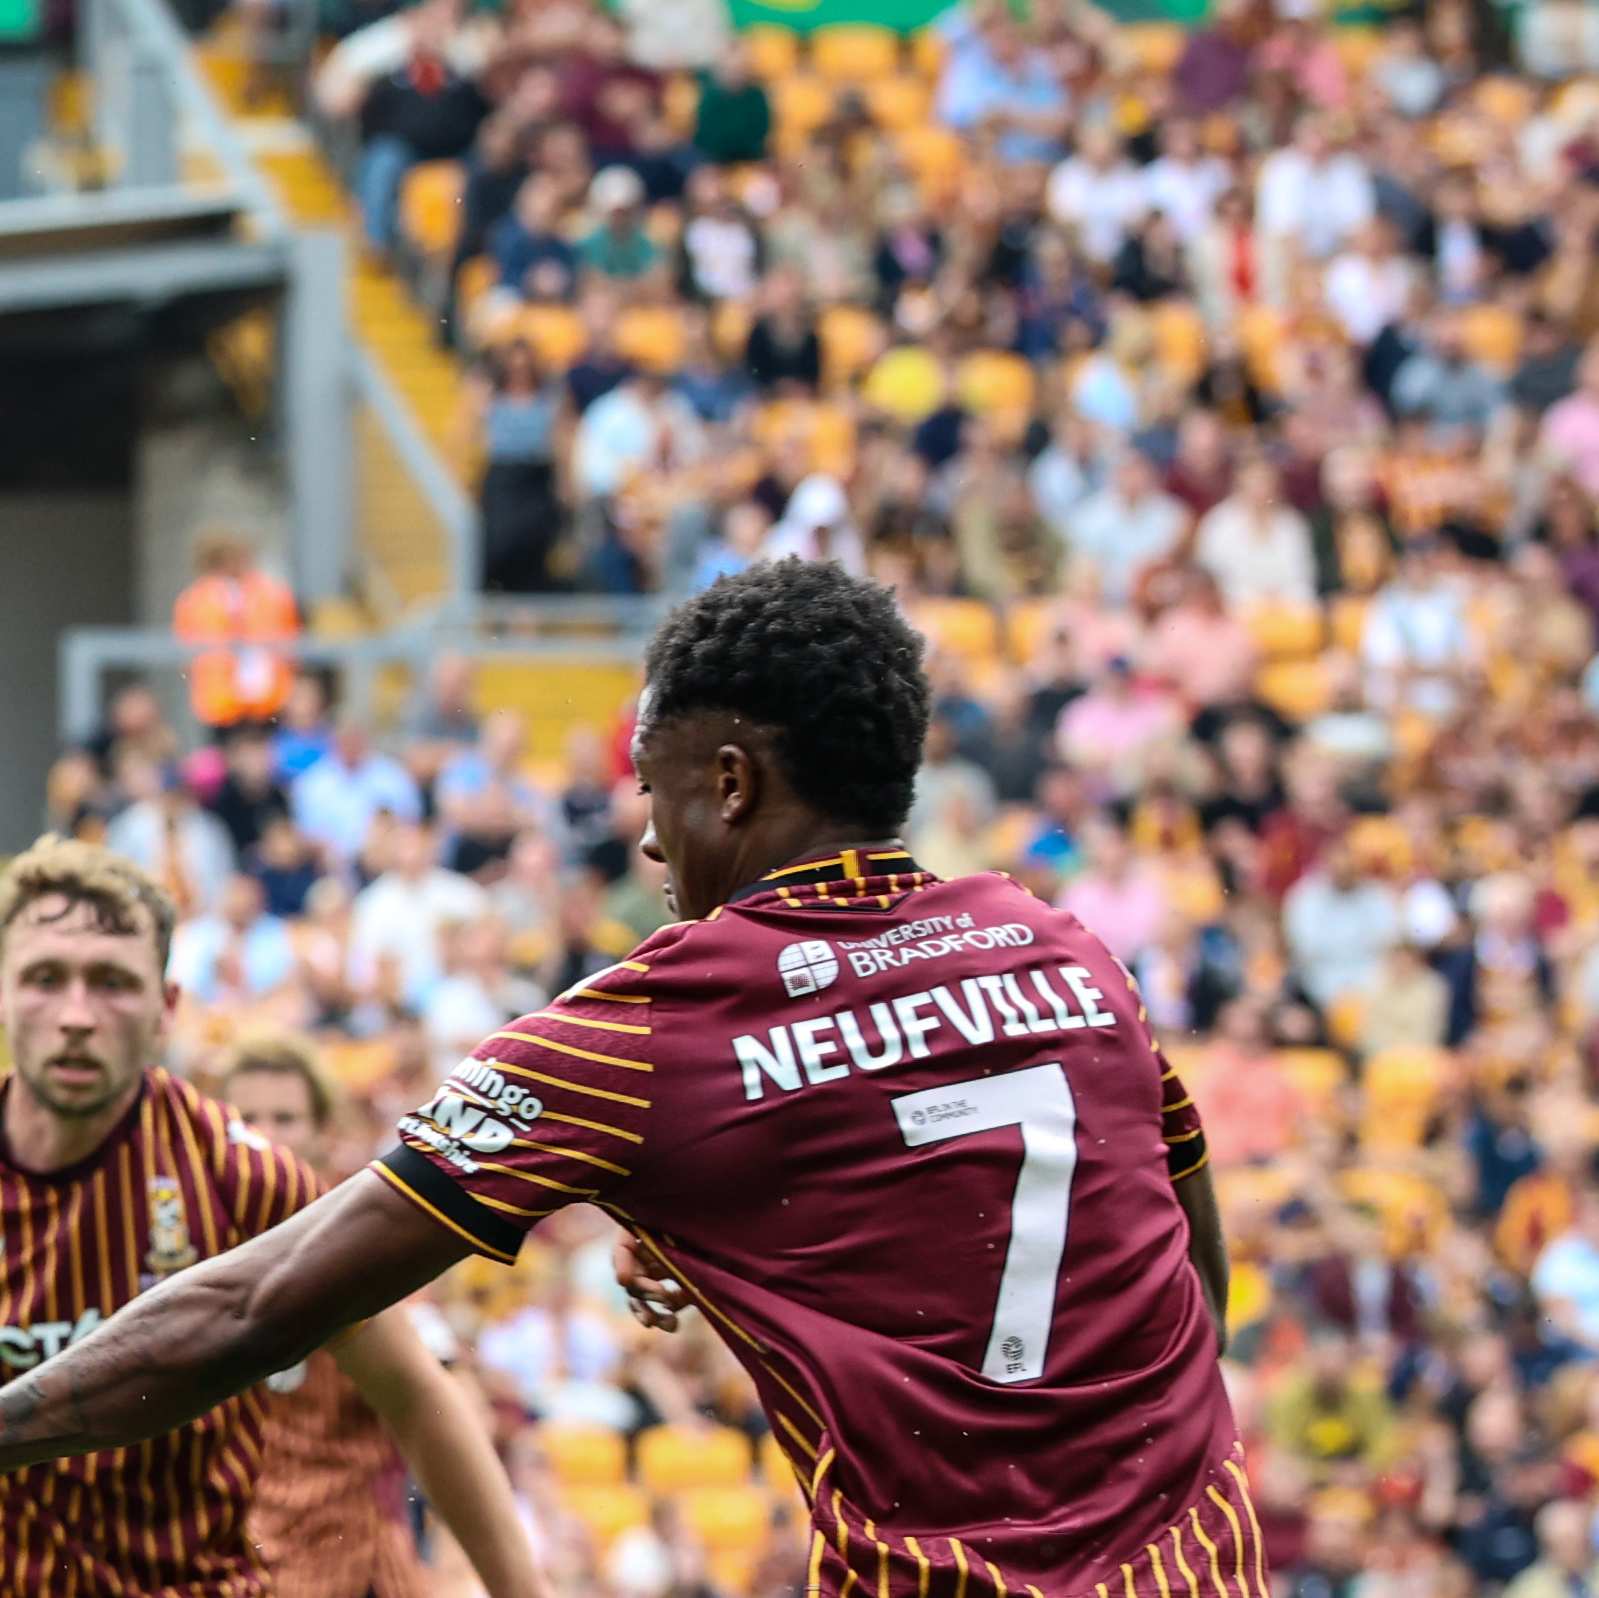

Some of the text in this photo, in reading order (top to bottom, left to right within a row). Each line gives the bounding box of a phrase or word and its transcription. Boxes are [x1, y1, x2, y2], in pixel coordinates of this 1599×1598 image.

[846, 922, 1035, 978] BRADFORD
[732, 965, 1118, 1101] NEUFVILLE
[892, 1063, 1078, 1384] 7
